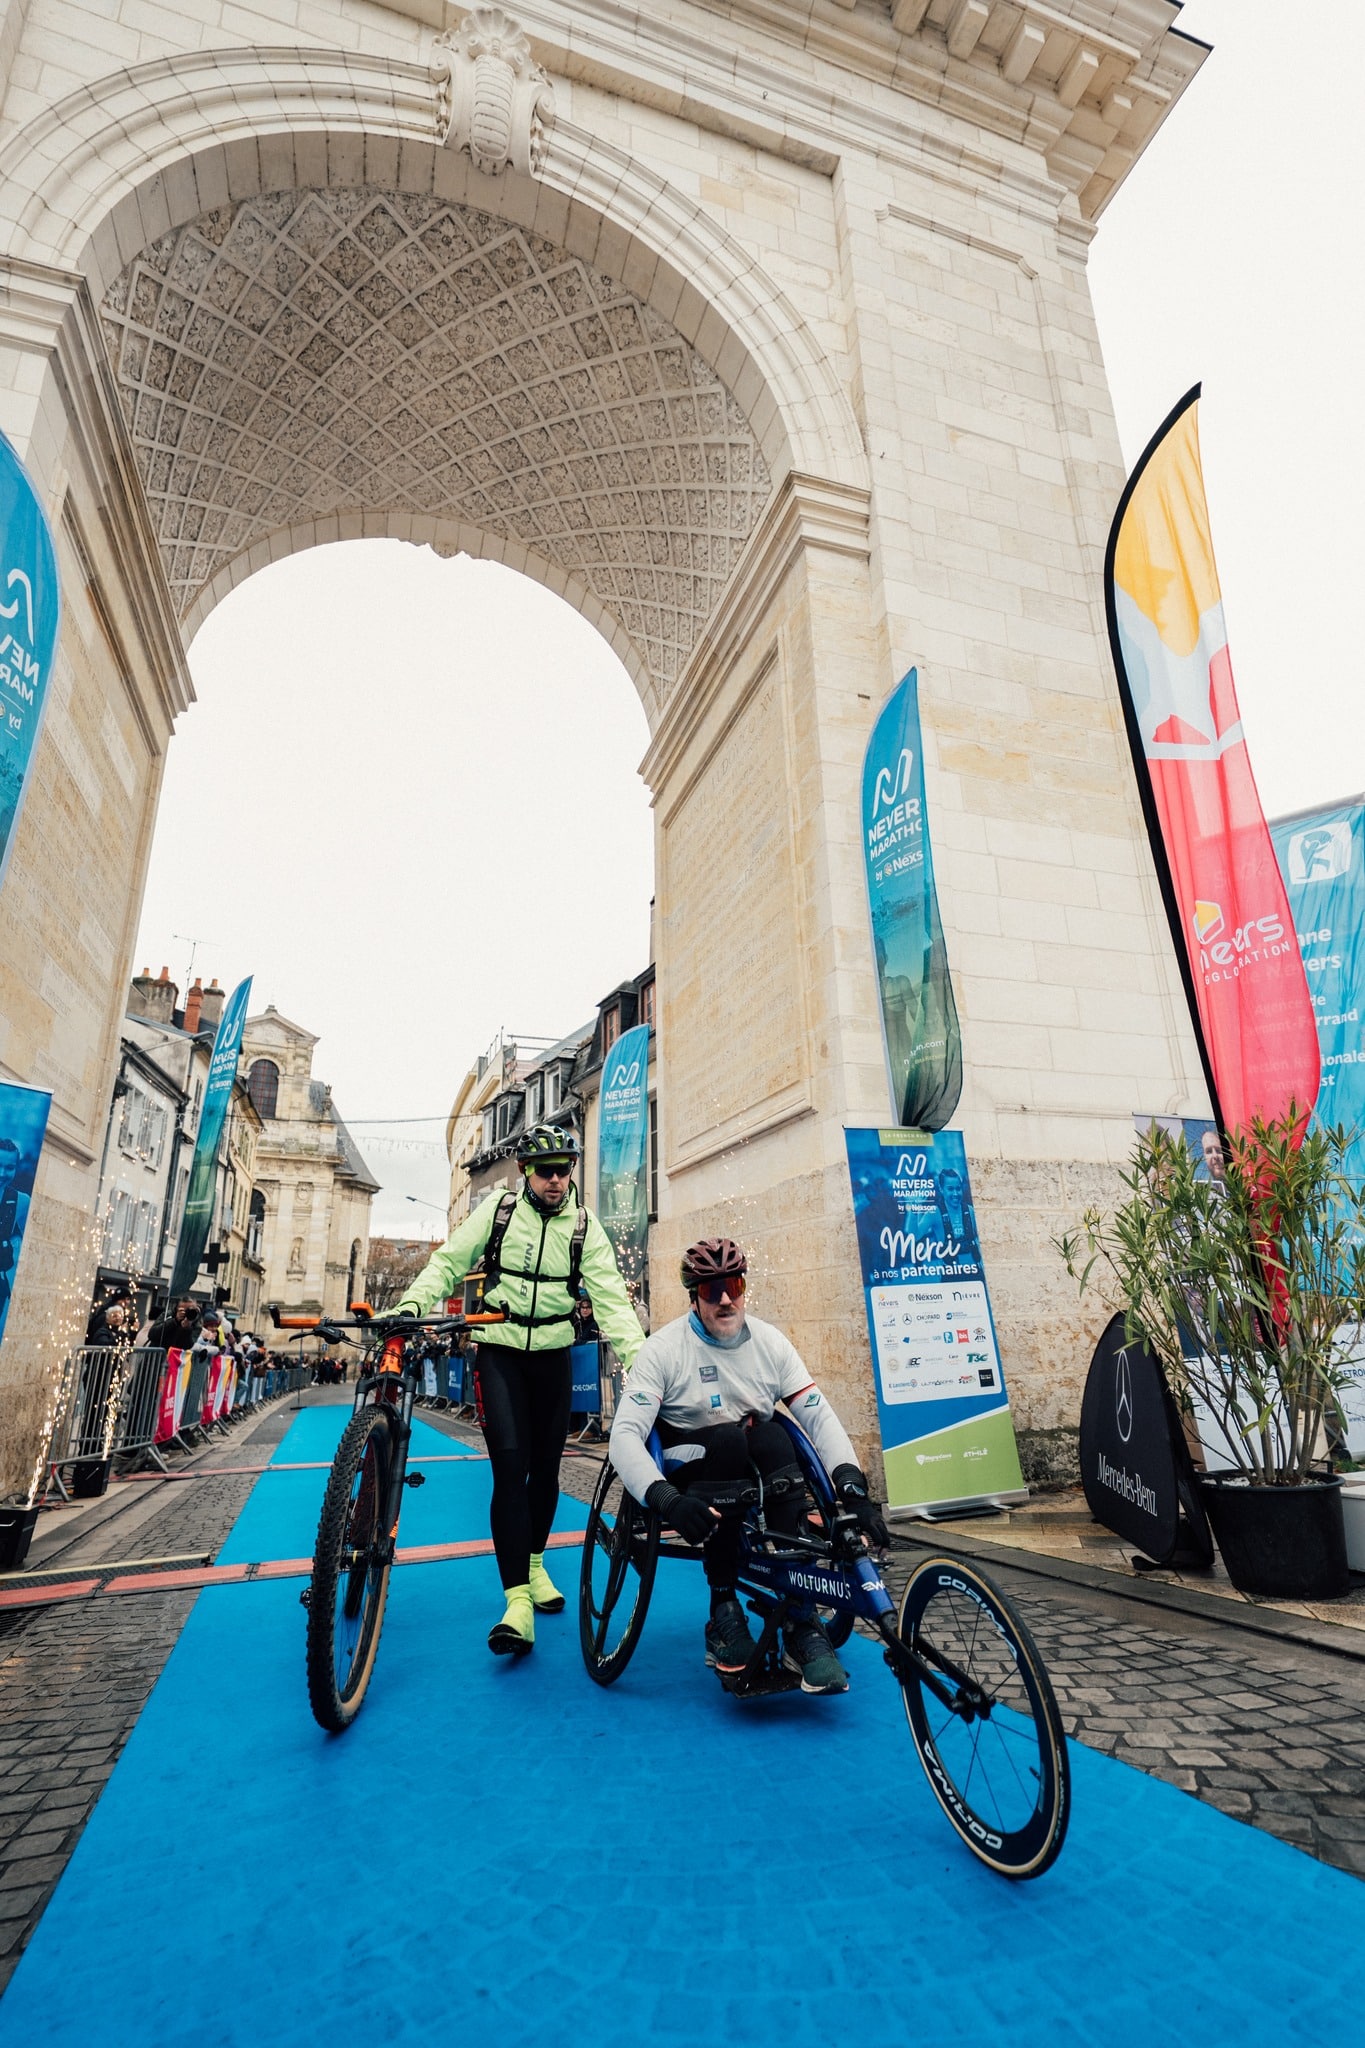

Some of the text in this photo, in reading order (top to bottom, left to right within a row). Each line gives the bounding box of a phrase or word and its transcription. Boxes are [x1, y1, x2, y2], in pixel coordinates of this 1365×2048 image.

[868, 798, 921, 847] NEVER
[870, 818, 923, 861] MARATHO
[875, 869, 883, 881] by
[893, 850, 924, 872] Nexs
[604, 1097, 640, 1109] MARATHON
[605, 1086, 640, 1101] NEVERS
[892, 1179, 935, 1189] NEVERS
[893, 1190, 936, 1198] MARATHON
[880, 1226, 961, 1268] Merci
[873, 1262, 978, 1280] à nos partenaires
[915, 1293, 943, 1301] Nexson
[1097, 1452, 1158, 1517] Mercedes-Benz
[788, 1570, 852, 1601] WOLTURNUS
[938, 1574, 1018, 1662] CORIMA
[924, 1739, 1003, 1851] CORIMA
